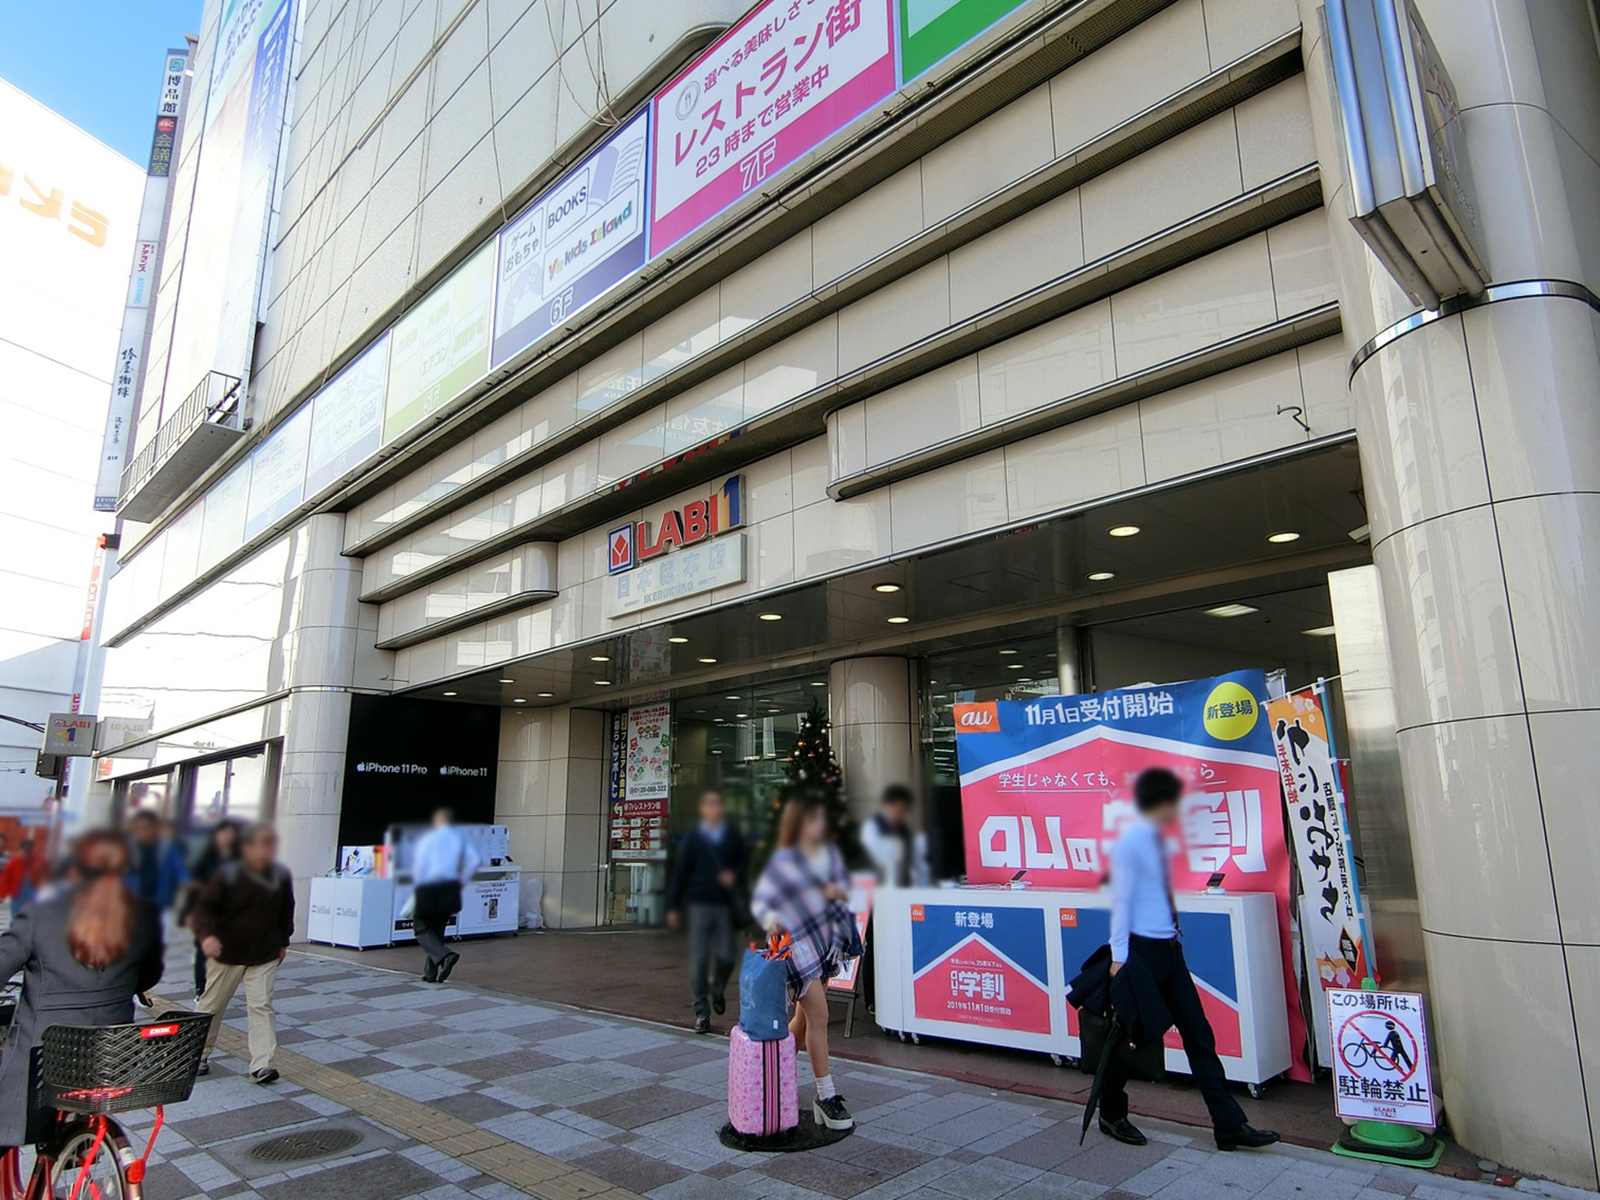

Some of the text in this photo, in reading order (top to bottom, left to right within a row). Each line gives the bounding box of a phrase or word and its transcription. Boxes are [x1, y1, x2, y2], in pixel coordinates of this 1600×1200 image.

[162, 75, 182, 113] 博品館
[675, 0, 862, 167] レストラン街
[151, 133, 173, 176] 会議室
[740, 140, 776, 192] 7F
[547, 185, 588, 231] BOOKS
[511, 220, 537, 251] ゲーム
[564, 238, 589, 269] kids
[589, 200, 633, 248] Island
[504, 237, 541, 274] おもちゃ
[549, 286, 575, 326] 6F
[617, 542, 727, 600] 日本総本店
[643, 581, 693, 604] IKEBUKURO
[960, 710, 993, 727] au
[1025, 691, 1174, 725] 11月1日受付開始
[1207, 699, 1254, 719] 新登場
[62, 720, 91, 729] LABI
[365, 762, 428, 775] iPhone 11 Pro
[447, 765, 488, 777] iPhone 11
[999, 772, 1117, 788] 学生じゃなくても、
[978, 789, 1268, 874] auの割
[912, 908, 924, 918] au
[954, 911, 994, 929] 新登場
[1061, 913, 1077, 923] au
[946, 1000, 1012, 1016] 2019年11月1日受付開始
[1332, 992, 1418, 1013] この場所は、
[1338, 1075, 1429, 1103] 駐輪禁止
